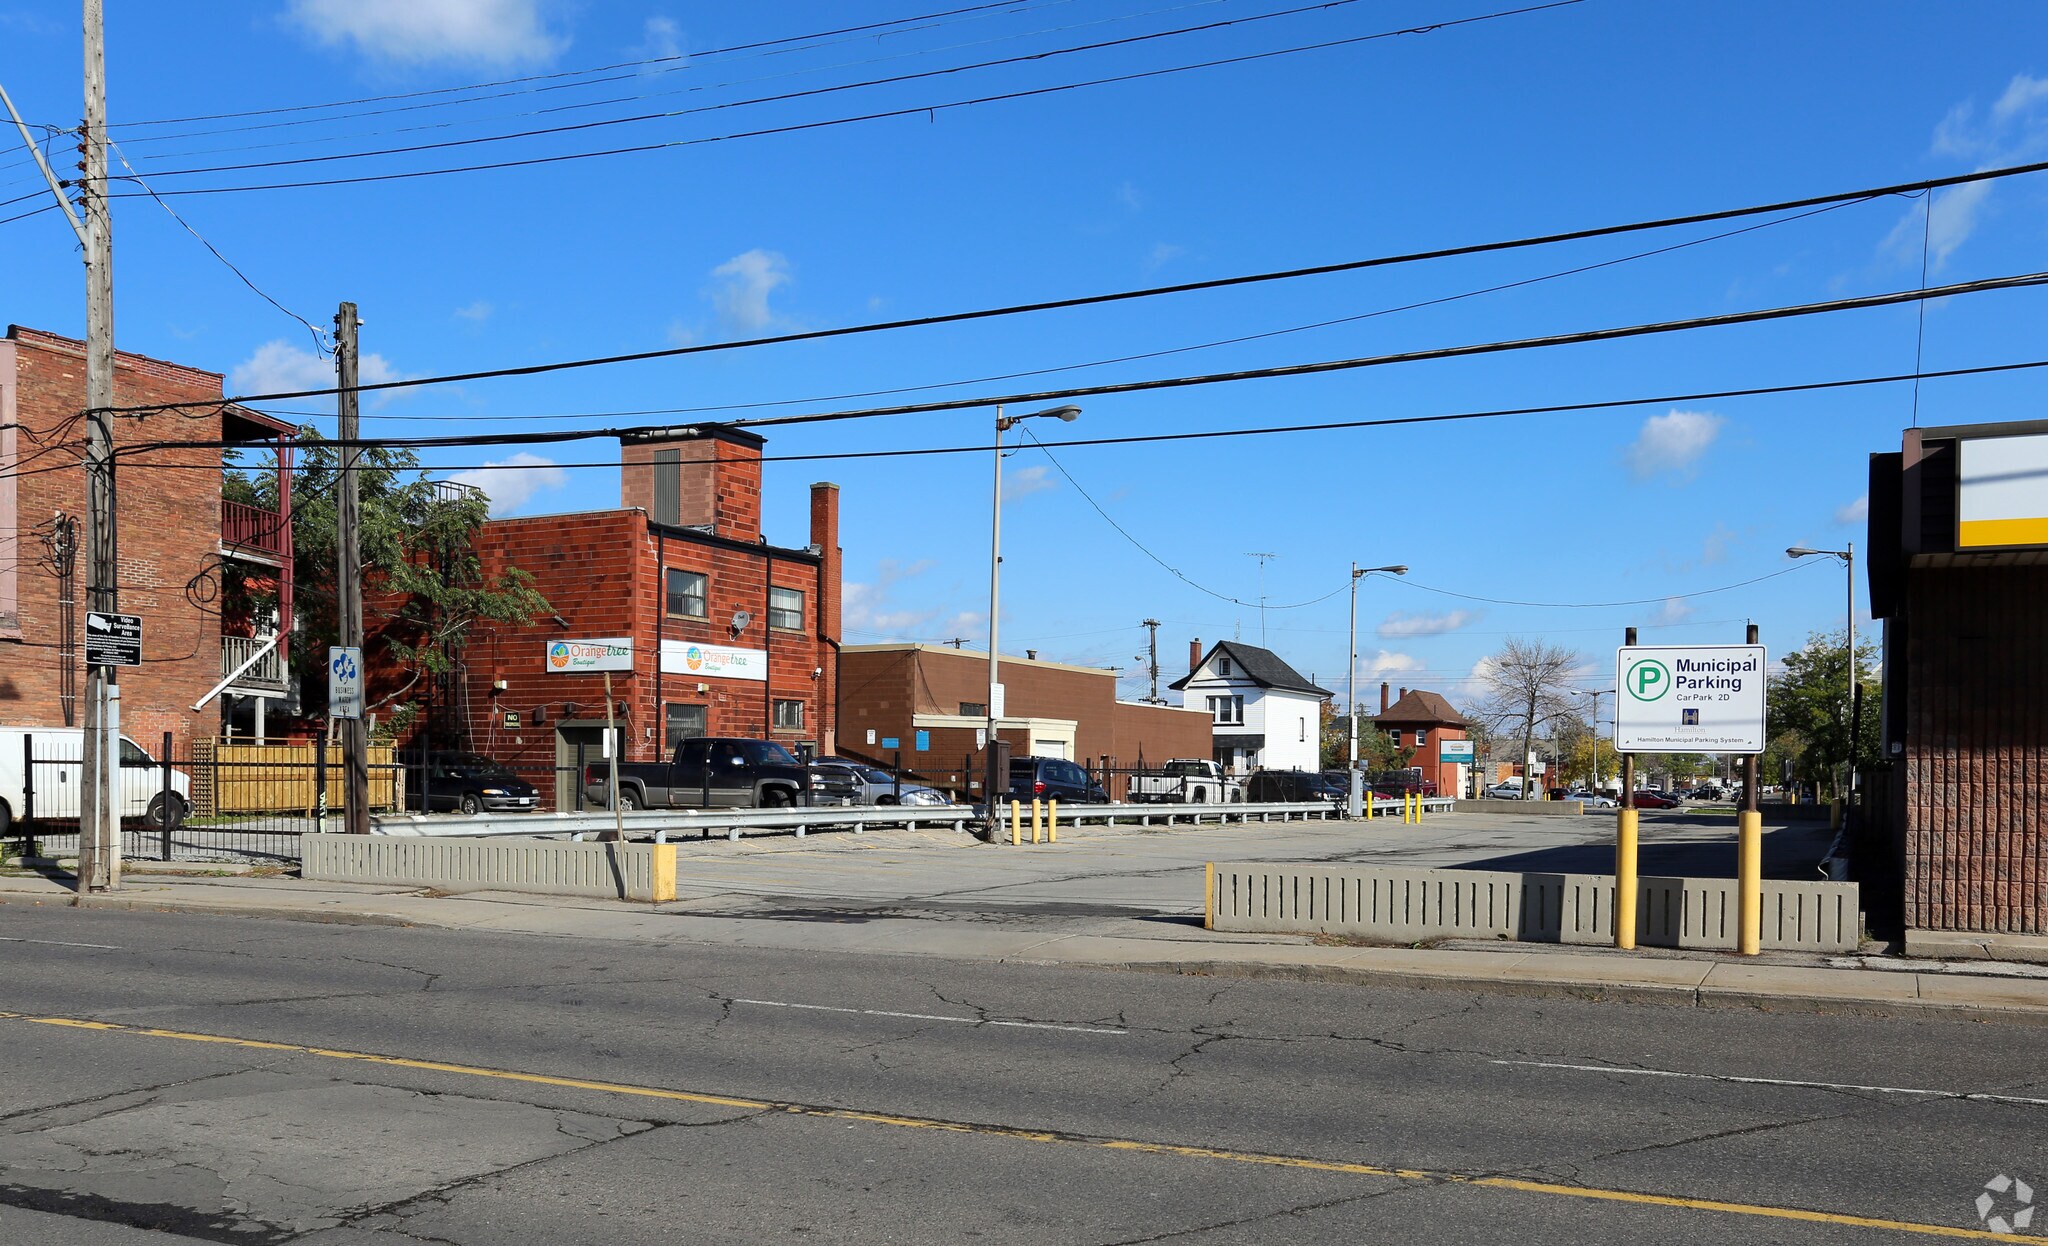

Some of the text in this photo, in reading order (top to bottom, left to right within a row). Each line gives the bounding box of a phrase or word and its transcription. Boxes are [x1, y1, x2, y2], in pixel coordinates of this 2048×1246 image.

[113, 622, 140, 631] Surveillance
[572, 657, 596, 667] Boutique
[704, 662, 721, 672] Boutique
[1676, 658, 1757, 675] Municipal
[1638, 666, 1661, 694] P
[1676, 675, 1742, 692] Parking
[1676, 693, 1730, 701] Car Park 2D
[1665, 736, 1694, 744] Municipal
[1695, 736, 1719, 744] Parking
[1720, 736, 1744, 744] System
